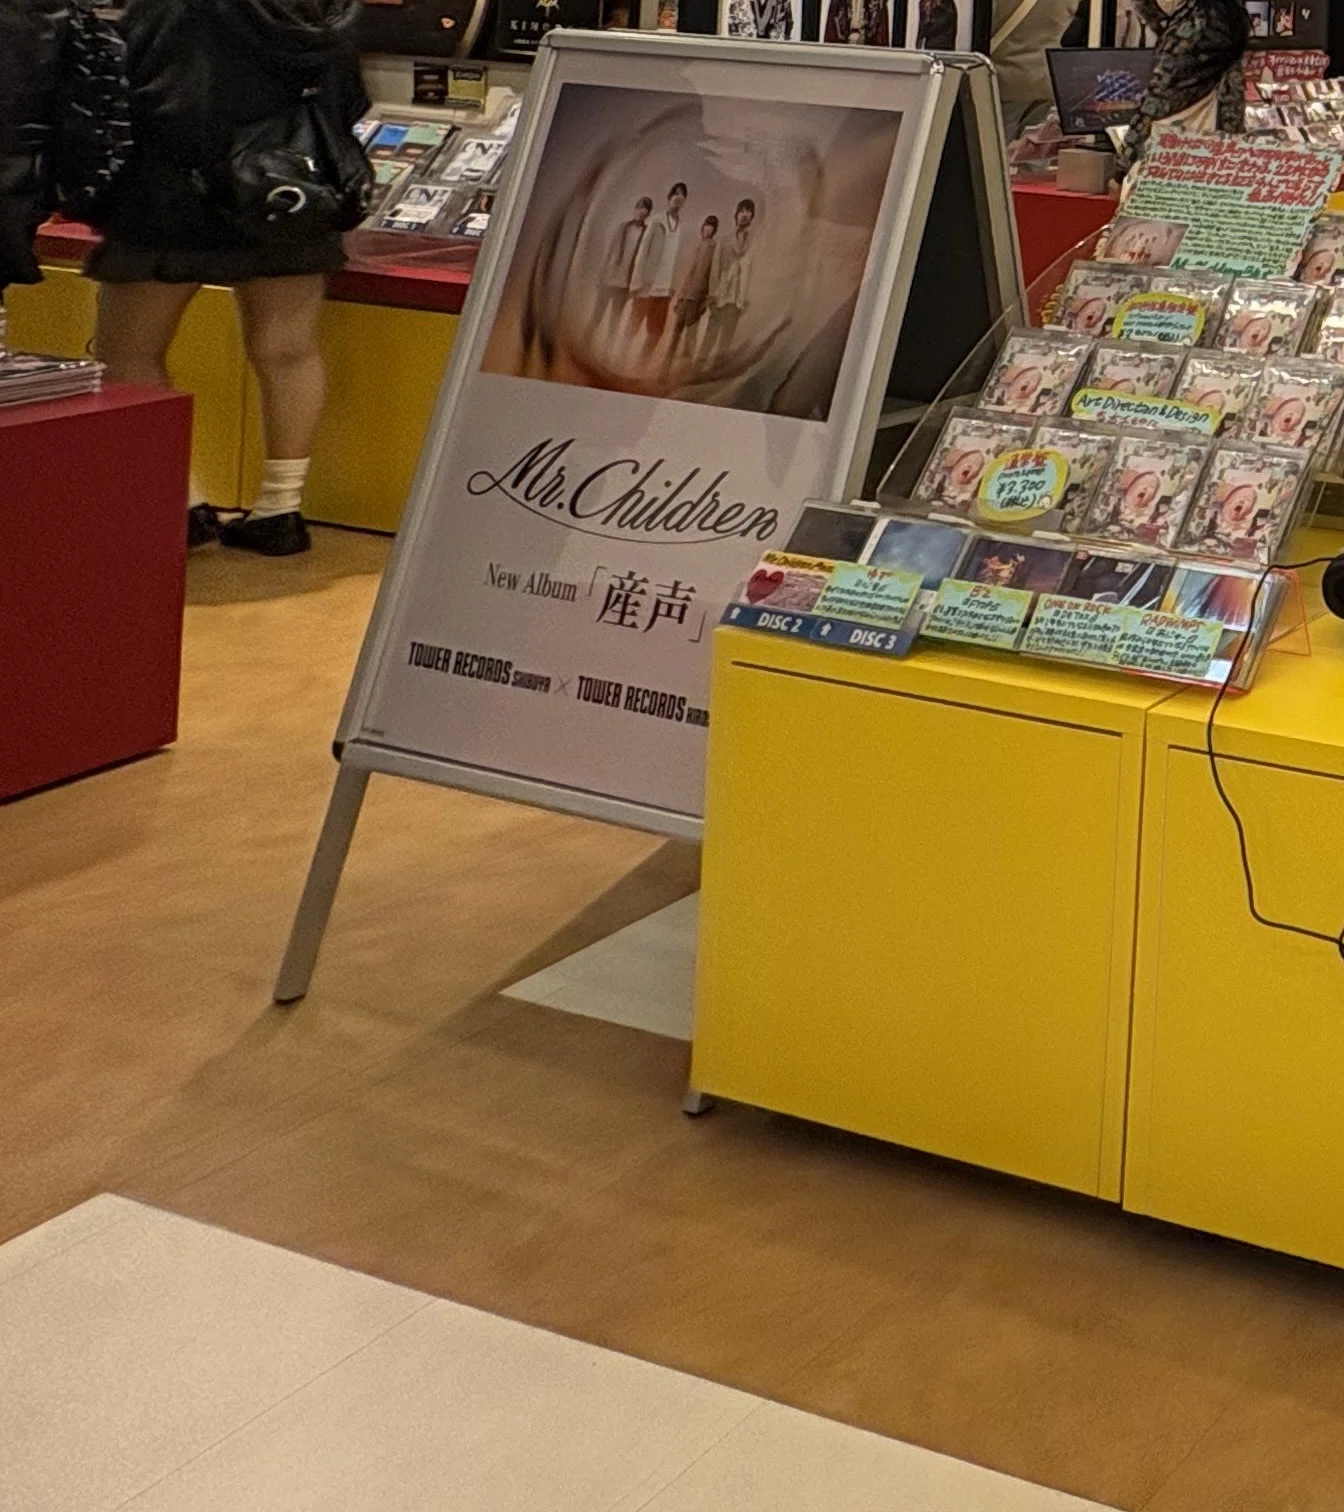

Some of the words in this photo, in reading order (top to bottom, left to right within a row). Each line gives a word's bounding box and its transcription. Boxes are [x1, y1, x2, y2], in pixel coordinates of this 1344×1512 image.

[484, 562, 521, 589] New
[523, 569, 578, 602] Album
[587, 565, 707, 644] 「産声」
[757, 611, 793, 631] DISC
[792, 617, 803, 633] 2
[848, 628, 884, 649] DISC
[884, 633, 897, 650] 3
[407, 641, 452, 673] TOWER
[452, 650, 514, 687] RECORDS
[576, 675, 622, 709] TOWER
[623, 685, 687, 723] RECORDS
